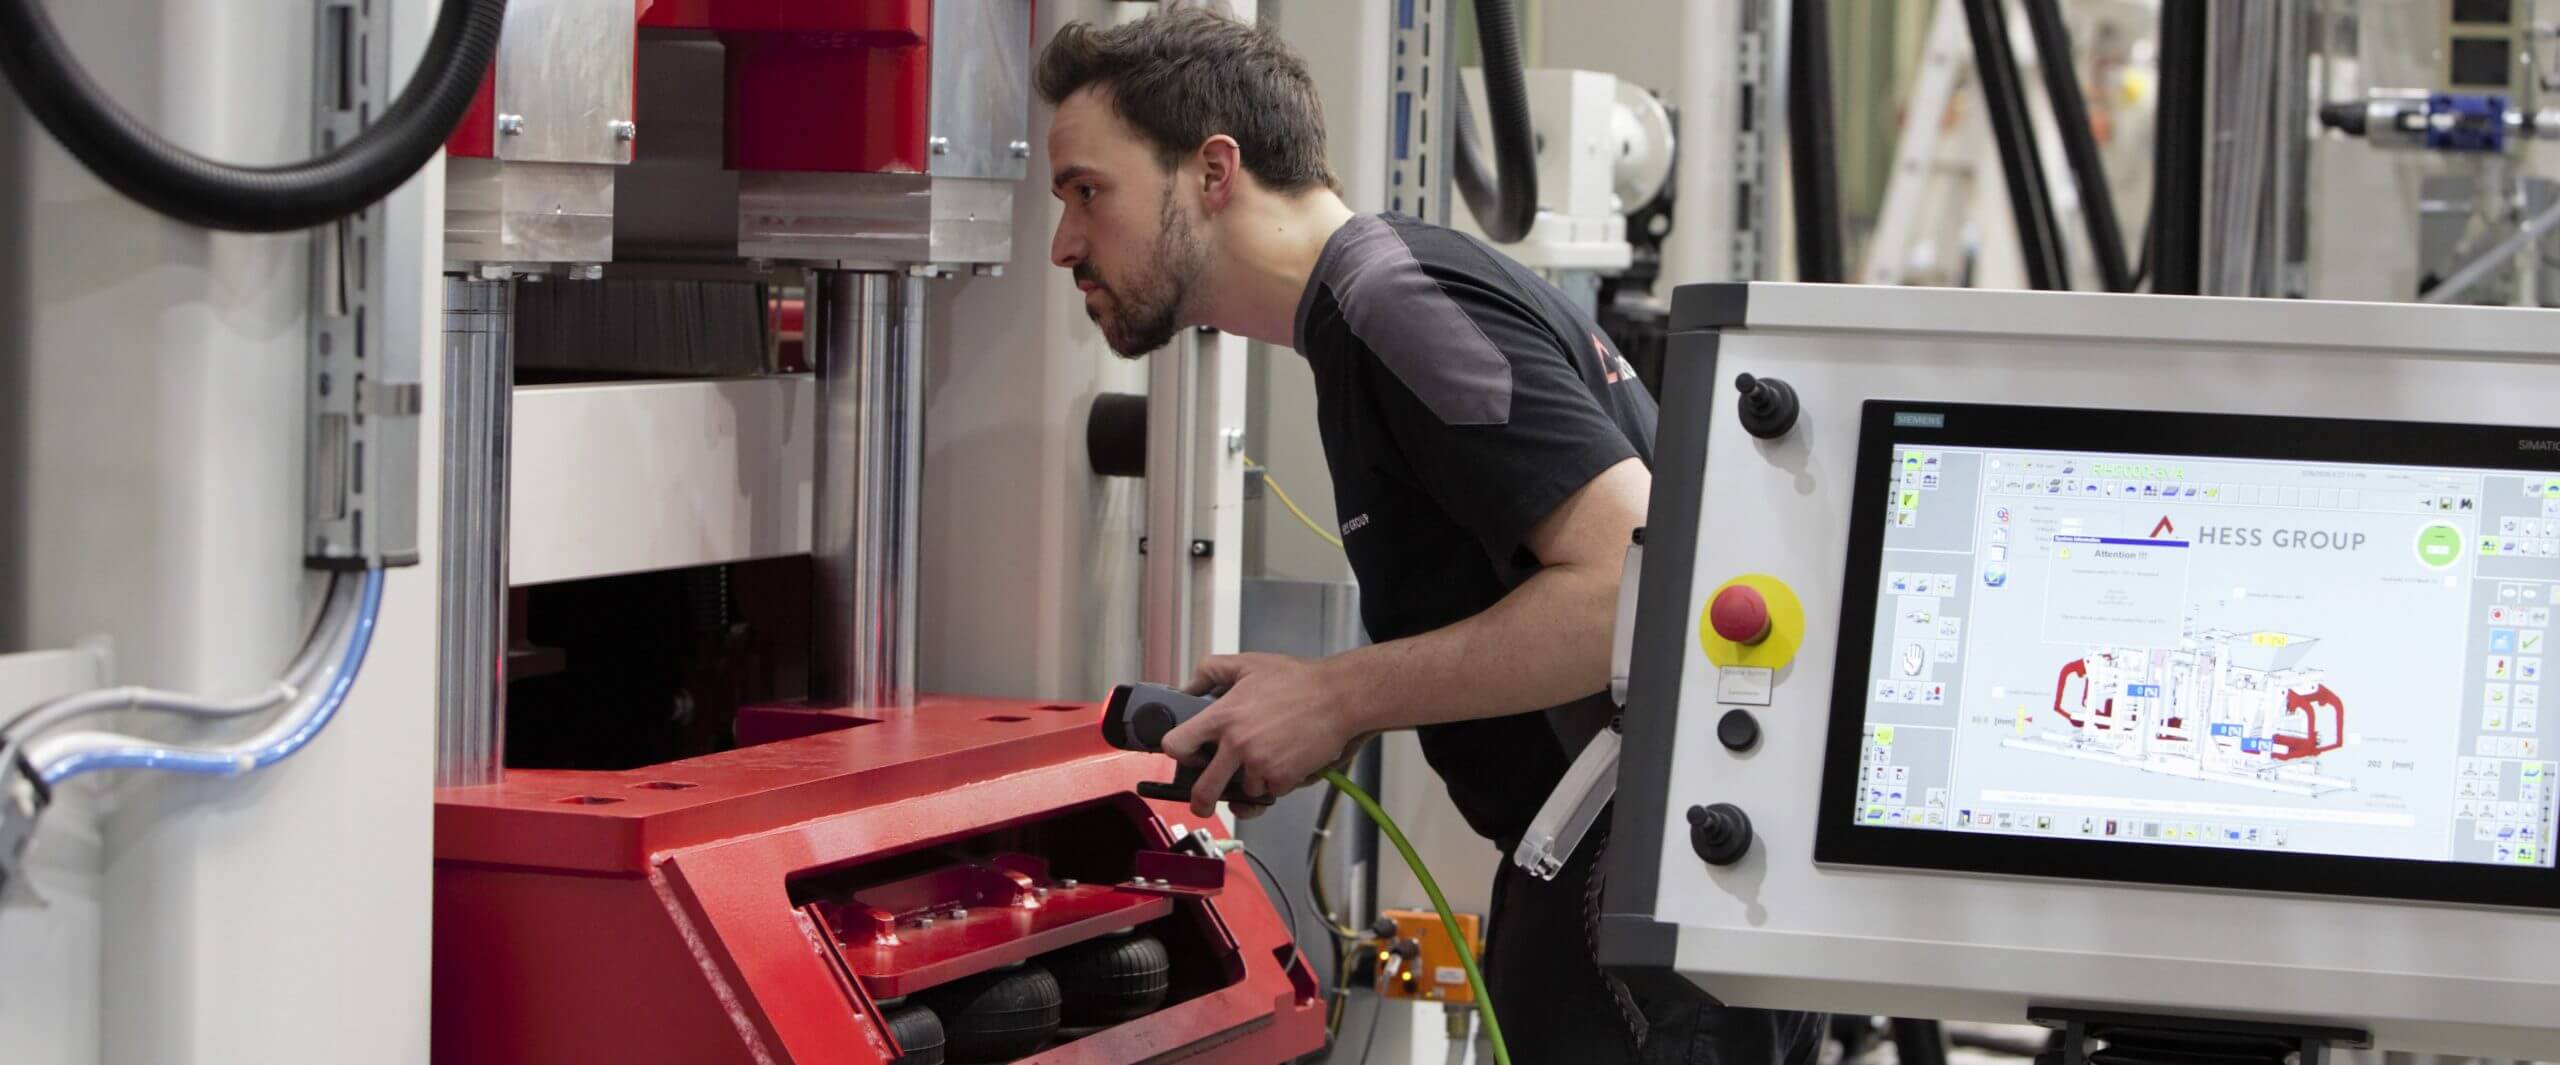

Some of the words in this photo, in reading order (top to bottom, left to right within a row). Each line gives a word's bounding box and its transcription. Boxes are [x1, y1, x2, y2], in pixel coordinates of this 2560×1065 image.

[1896, 414, 1942, 426] SIEMENS
[2198, 525, 2263, 547] HESS
[2272, 528, 2367, 552] GROUP
[2094, 549, 2137, 560] Attention
[2138, 551, 2148, 560] !!!
[1994, 715, 2017, 729] [mm]
[2391, 760, 2414, 771] [mm]
